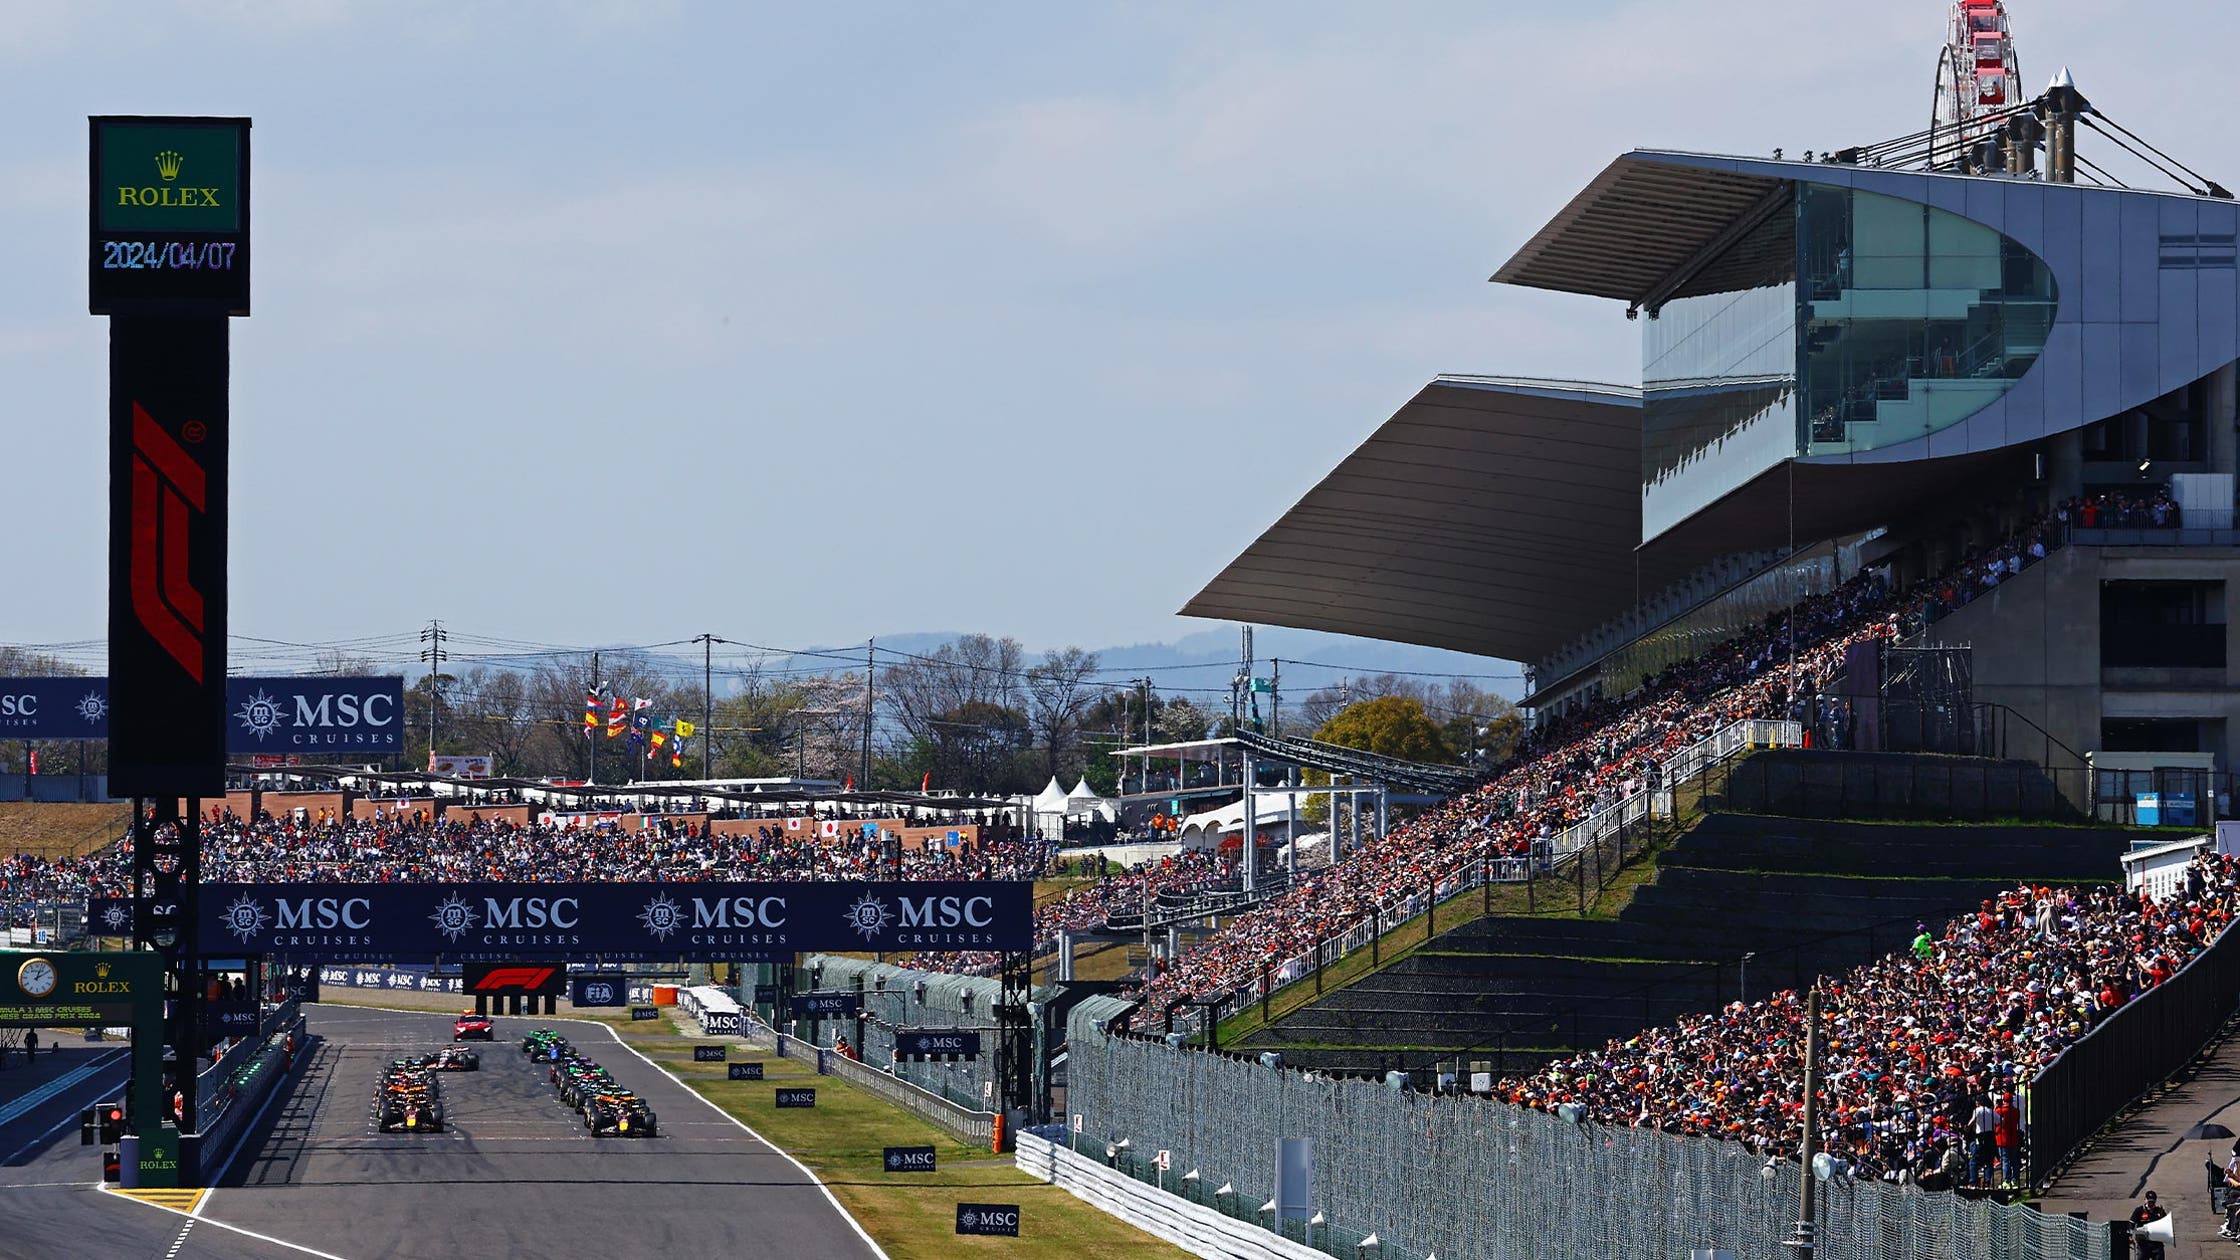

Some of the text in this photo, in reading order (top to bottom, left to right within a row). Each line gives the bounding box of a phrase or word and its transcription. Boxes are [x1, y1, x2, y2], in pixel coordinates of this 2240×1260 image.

[118, 186, 220, 207] ROLEX
[103, 241, 236, 270] 2024/04/07
[1, 695, 37, 715] SC
[293, 694, 393, 728] MSC
[293, 734, 393, 744] CRUISES
[275, 898, 370, 930] MSC
[484, 898, 579, 929] MSC
[692, 897, 786, 929] MSC
[898, 897, 993, 928] MSC
[274, 935, 371, 946] CRUISES
[483, 935, 579, 945] CRUISES
[691, 934, 786, 945] CRUISES
[897, 934, 993, 944] CRUISES
[75, 982, 130, 993] ROLEX
[587, 987, 610, 998] FIA
[819, 999, 842, 1008] MSC
[233, 1013, 255, 1021] MSC
[709, 1016, 738, 1029] MSC
[933, 1037, 962, 1048] MSC
[742, 1067, 762, 1075] MSC
[791, 1093, 814, 1102] MSC
[904, 1153, 934, 1164] MSC
[140, 1160, 177, 1170] ROLEX
[980, 1212, 1017, 1226] MSC
